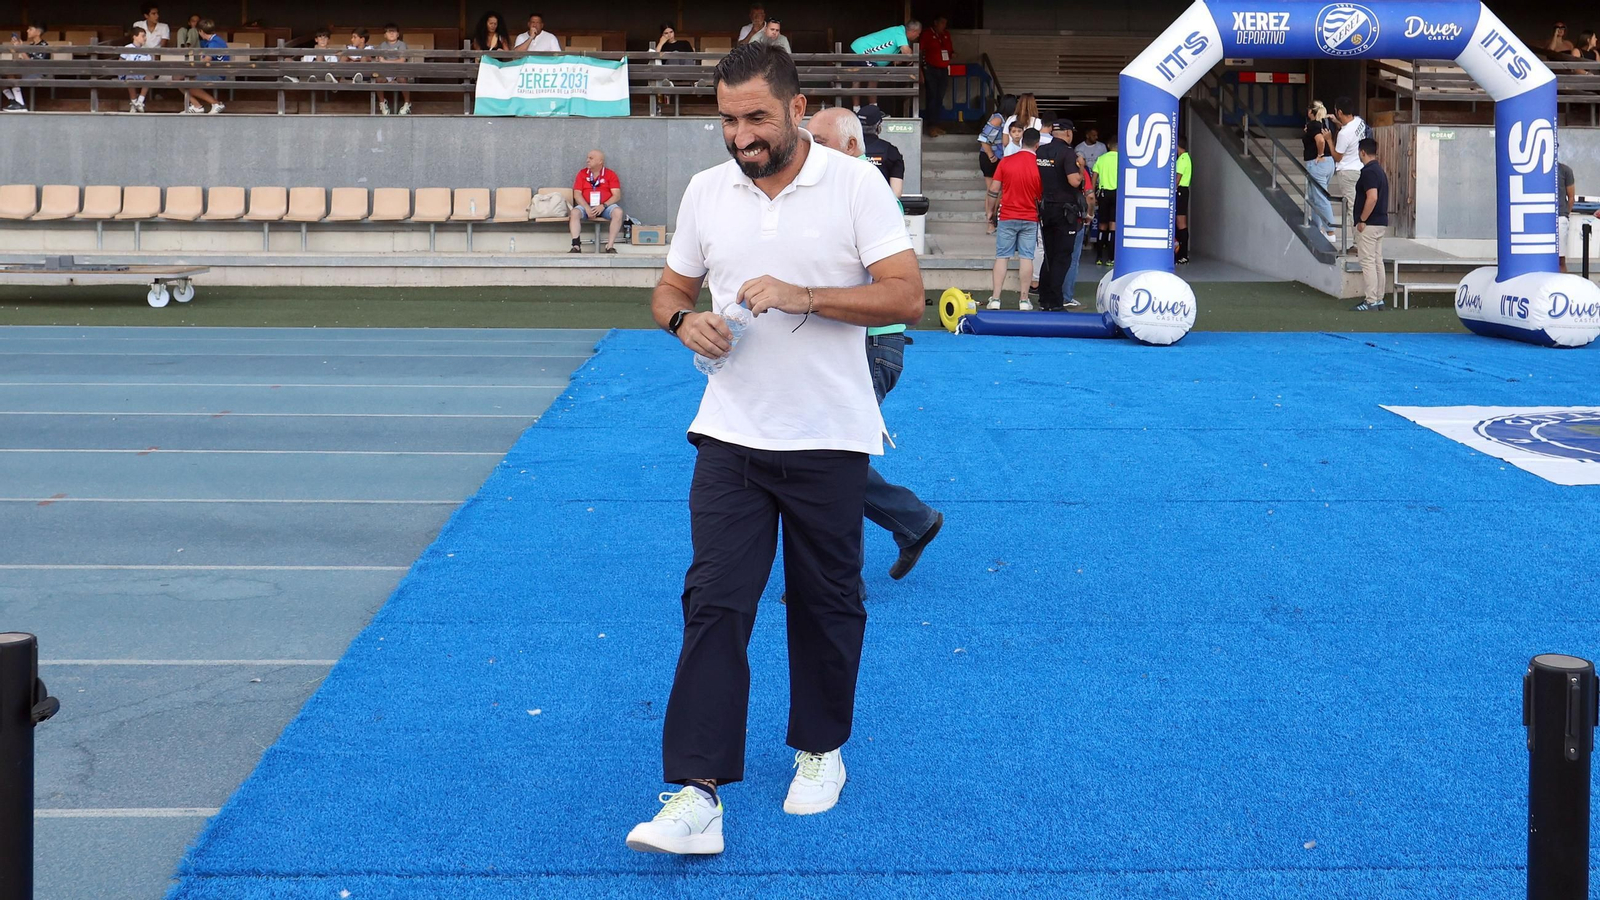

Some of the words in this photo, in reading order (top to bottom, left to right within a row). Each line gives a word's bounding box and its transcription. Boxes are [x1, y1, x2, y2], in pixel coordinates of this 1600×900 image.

[1232, 12, 1290, 30] XEREZ
[1404, 15, 1463, 38] Diver
[1236, 30, 1286, 45] DEPORTIVO
[1156, 31, 1209, 81] ITS
[1480, 29, 1531, 80] ITS
[517, 73, 558, 89] JEREZ
[560, 73, 589, 89] 2031
[1122, 112, 1172, 249] ITS
[1508, 118, 1556, 254] ITS
[1130, 288, 1191, 316] Diver
[1457, 284, 1482, 310] Diver
[1500, 294, 1530, 319] ITS
